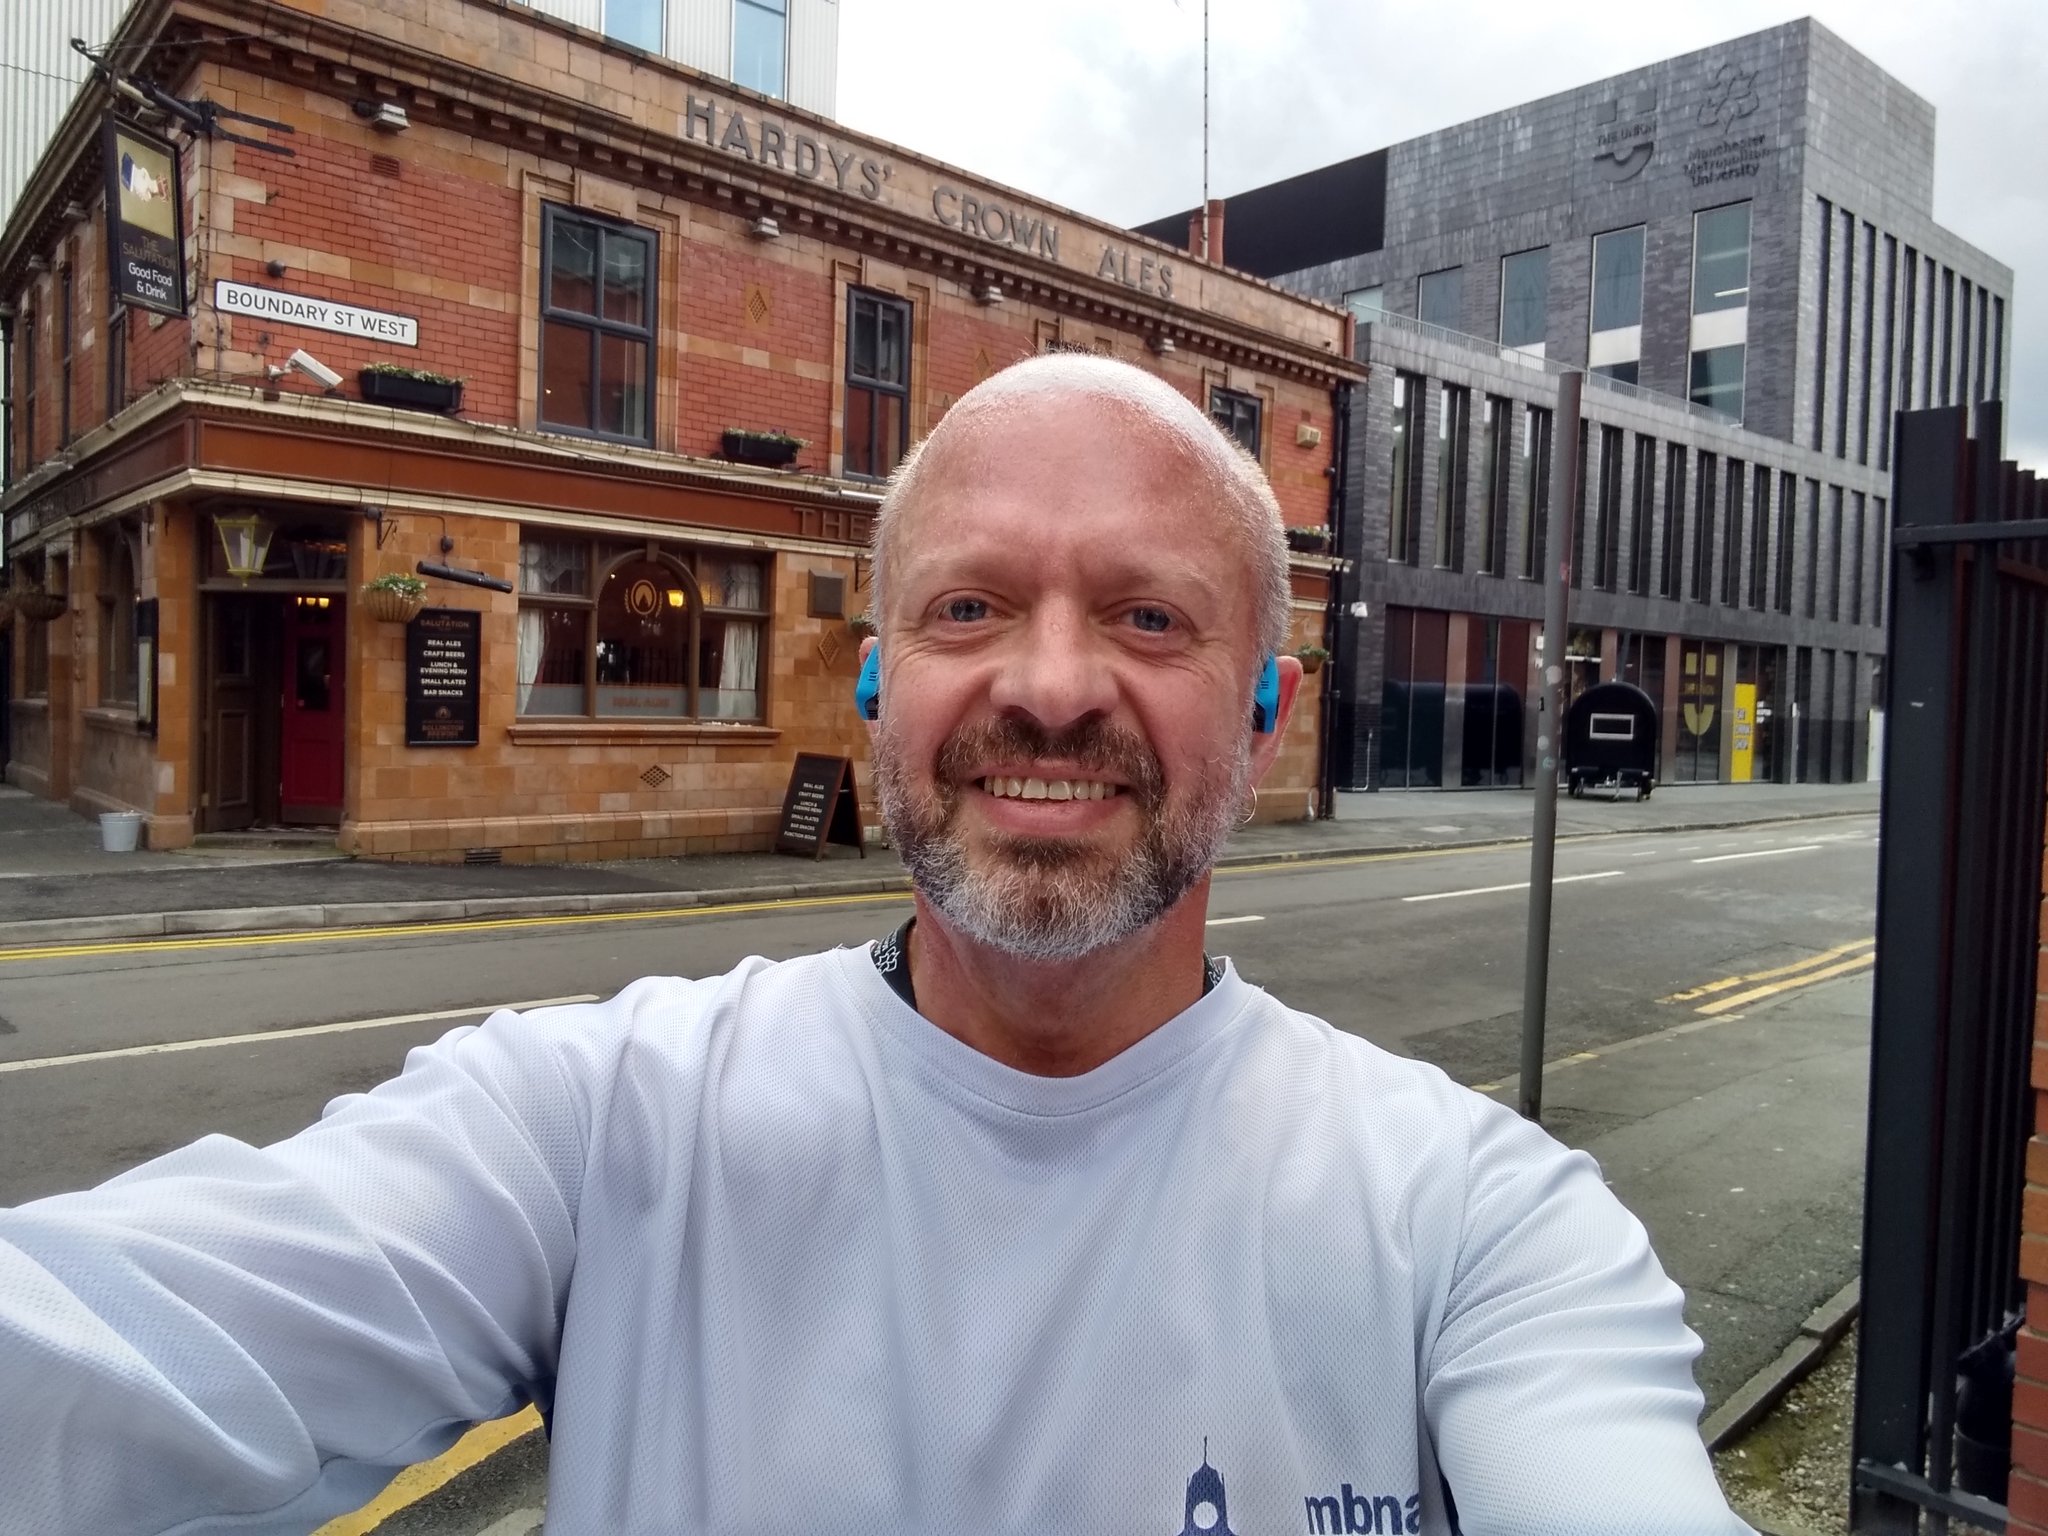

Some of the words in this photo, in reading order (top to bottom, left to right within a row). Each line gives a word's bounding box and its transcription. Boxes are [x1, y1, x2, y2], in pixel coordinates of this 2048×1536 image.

[1688, 134, 1765, 160] Manchester
[1683, 149, 1770, 176] Metropolitan
[1691, 162, 1760, 187] University
[141, 235, 159, 252] THE
[933, 184, 1061, 262] CROWN
[1098, 244, 1175, 299] ALES
[122, 242, 176, 271] SALUTATION
[128, 262, 151, 280] Good
[152, 269, 173, 287] Food
[136, 280, 145, 293] &
[145, 282, 167, 301] Drink
[227, 289, 329, 323] BOUNDARY
[334, 309, 355, 326] ST
[360, 314, 409, 338] WEST
[793, 507, 868, 541] THE
[420, 619, 470, 628] SALUTATION
[423, 650, 445, 658] CRAFT
[445, 651, 466, 659] BEERS
[427, 639, 445, 647] REAL
[420, 667, 449, 675] EVENING
[442, 678, 467, 686] PLATES
[438, 689, 464, 697] SNACKS
